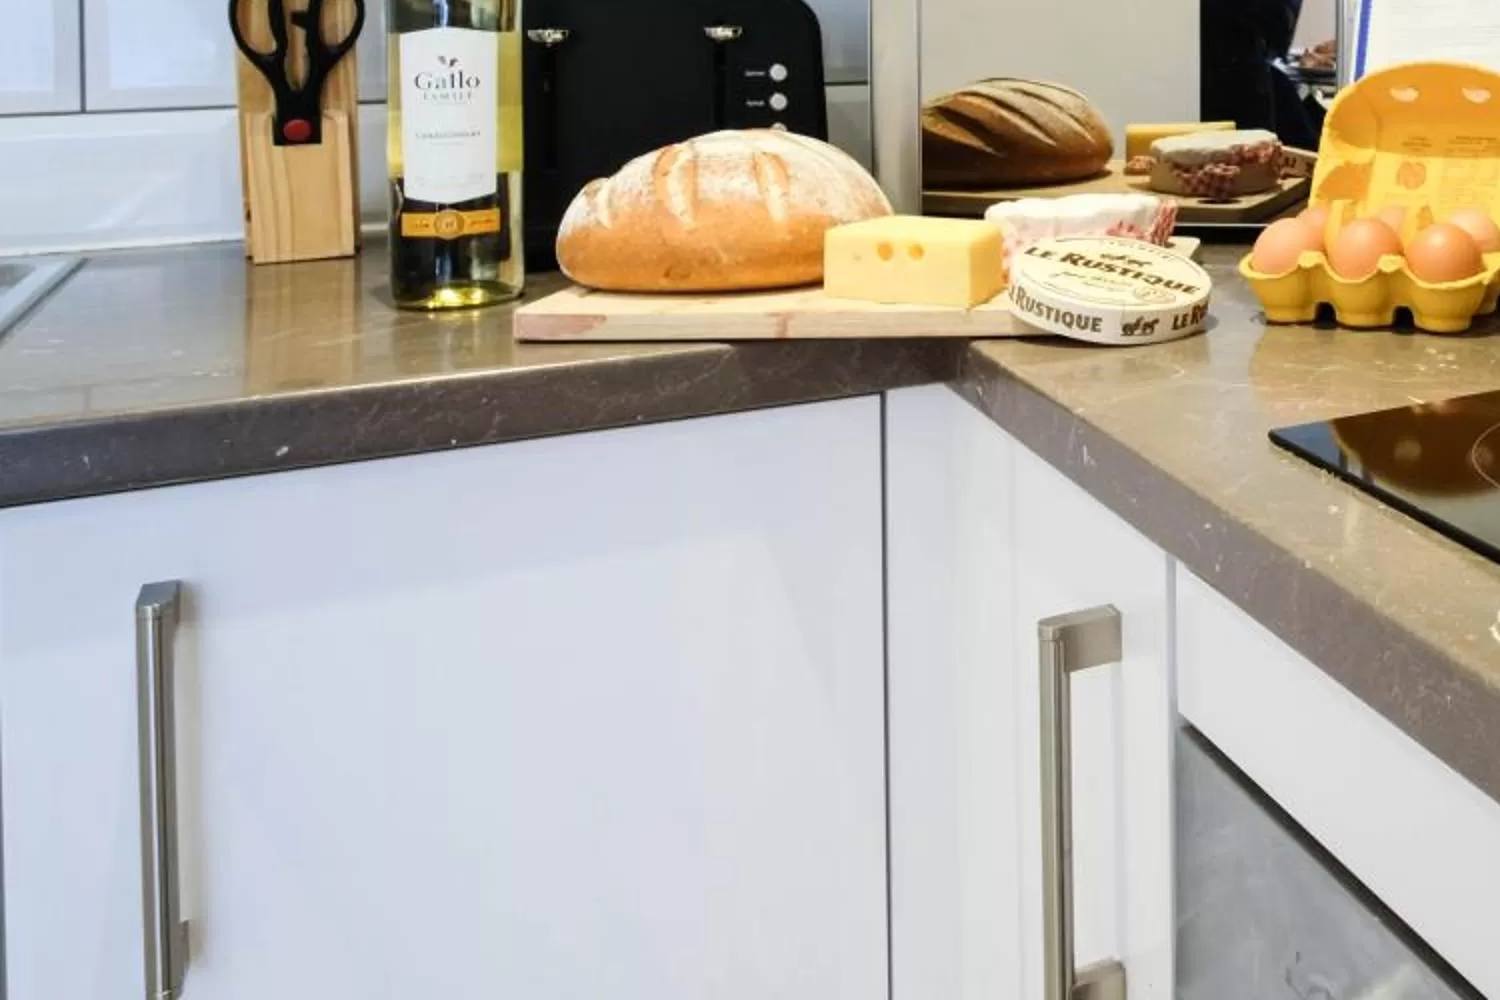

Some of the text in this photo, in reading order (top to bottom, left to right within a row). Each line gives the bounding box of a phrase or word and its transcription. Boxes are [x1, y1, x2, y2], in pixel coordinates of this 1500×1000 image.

[413, 70, 481, 90] Gallo
[1024, 246, 1057, 260] LE
[1060, 251, 1201, 294] RUSTIQUE
[1015, 286, 1103, 333] RUSTIQUE
[1171, 310, 1189, 331] LE
